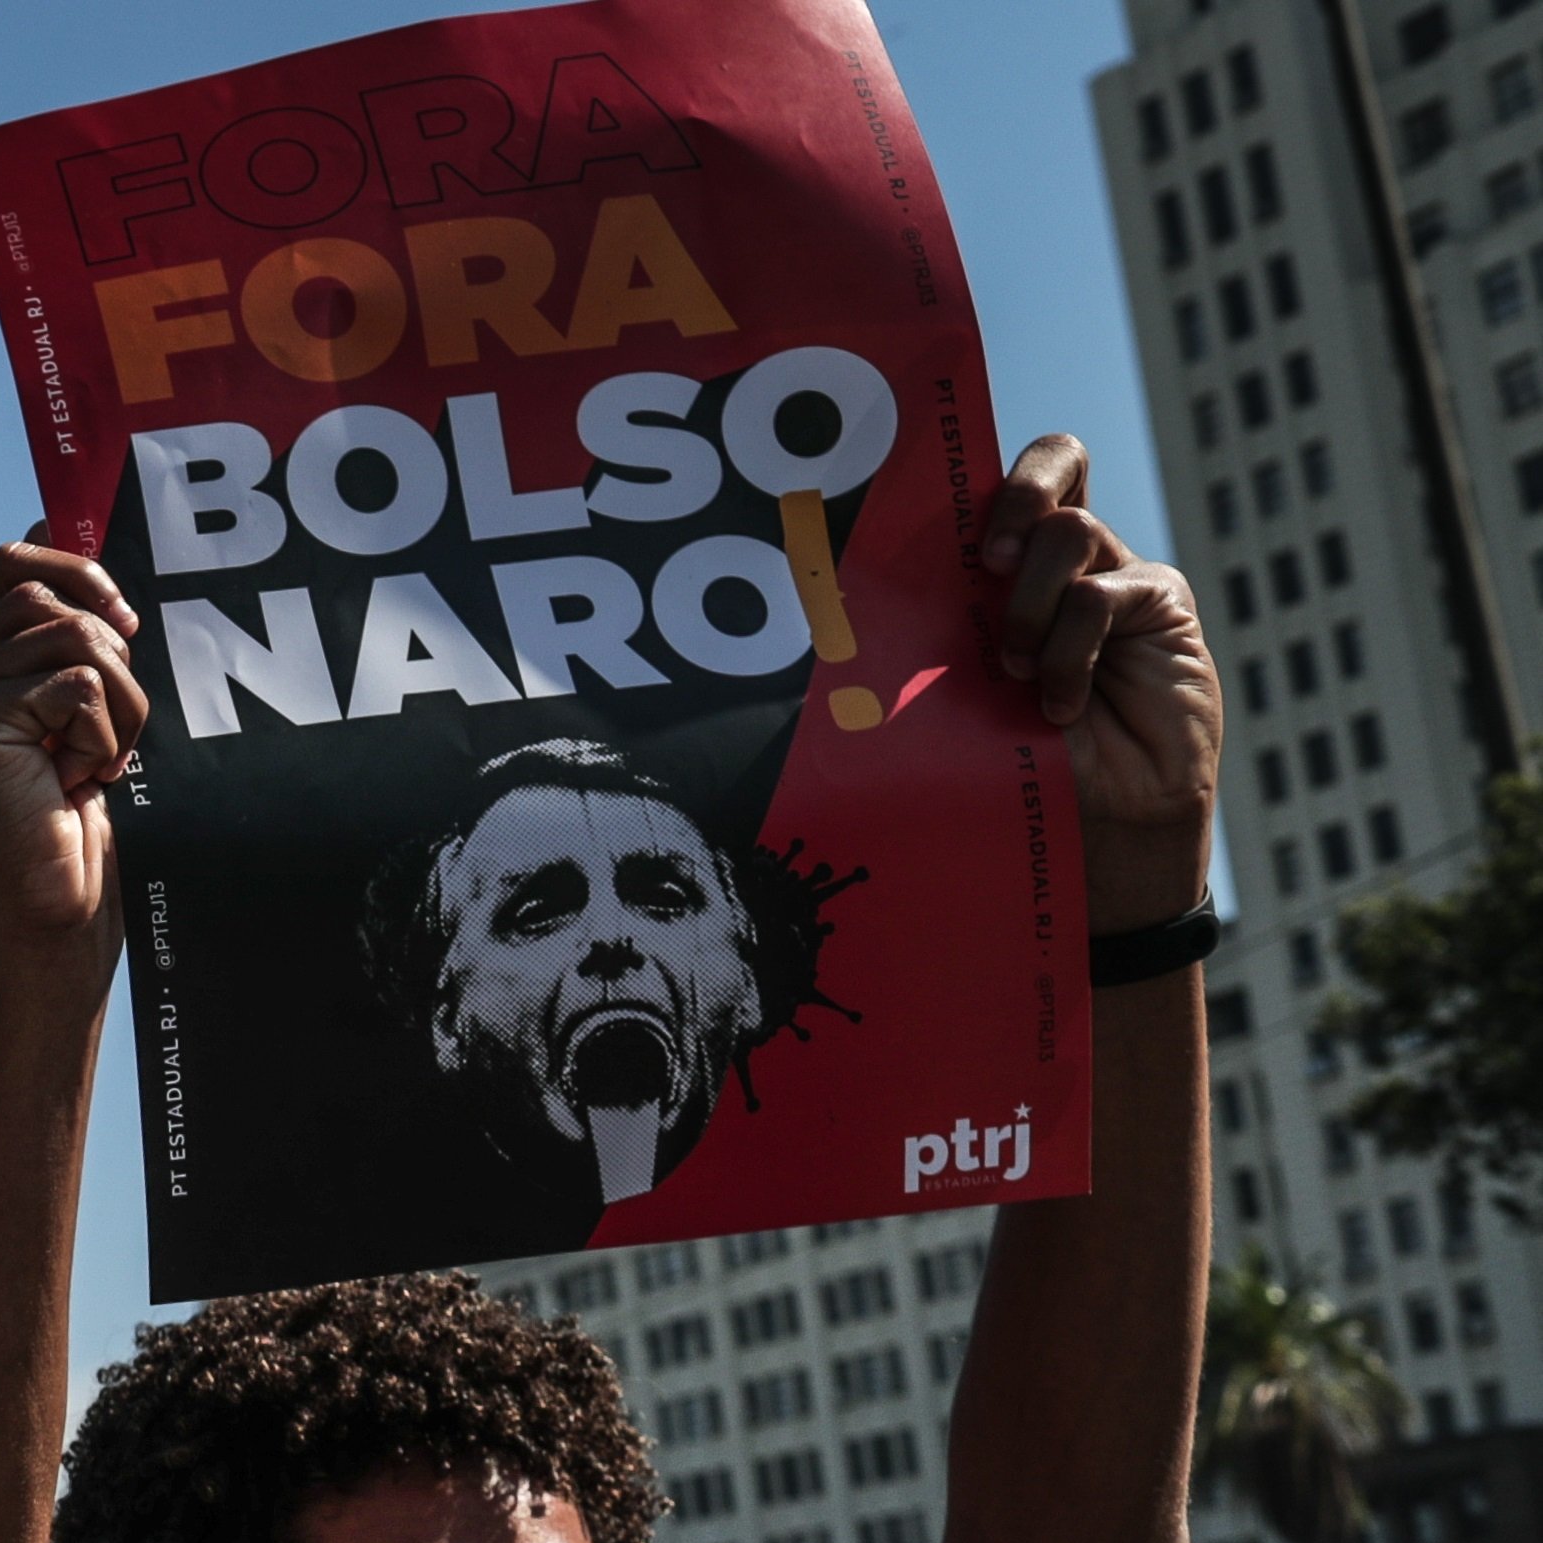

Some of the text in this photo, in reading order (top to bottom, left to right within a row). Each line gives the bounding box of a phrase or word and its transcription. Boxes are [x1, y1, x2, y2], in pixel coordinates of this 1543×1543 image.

[844, 50, 863, 70] PT
[853, 75, 899, 171] ESTADUAL
[56, 51, 701, 266] FORA
[889, 176, 909, 201] RJ
[24, 294, 45, 319] RJ
[93, 193, 739, 405] FORA
[32, 322, 70, 427] ESTADUAL
[935, 377, 956, 405] PT
[60, 432, 78, 454] PT
[130, 345, 898, 575] BOLSO
[940, 412, 974, 536] ESTADUAL
[960, 541, 979, 571] RJ
[1015, 744, 1036, 773] PT
[133, 781, 152, 805] PT
[1021, 778, 1052, 907] ESTADUAL
[1034, 912, 1053, 941] RJ
[148, 880, 189, 1197] PT ESTADUAL RJ @PTRJ13
[903, 1102, 1032, 1194] ptrj
[925, 1172, 1000, 1193] ESTADUAL
